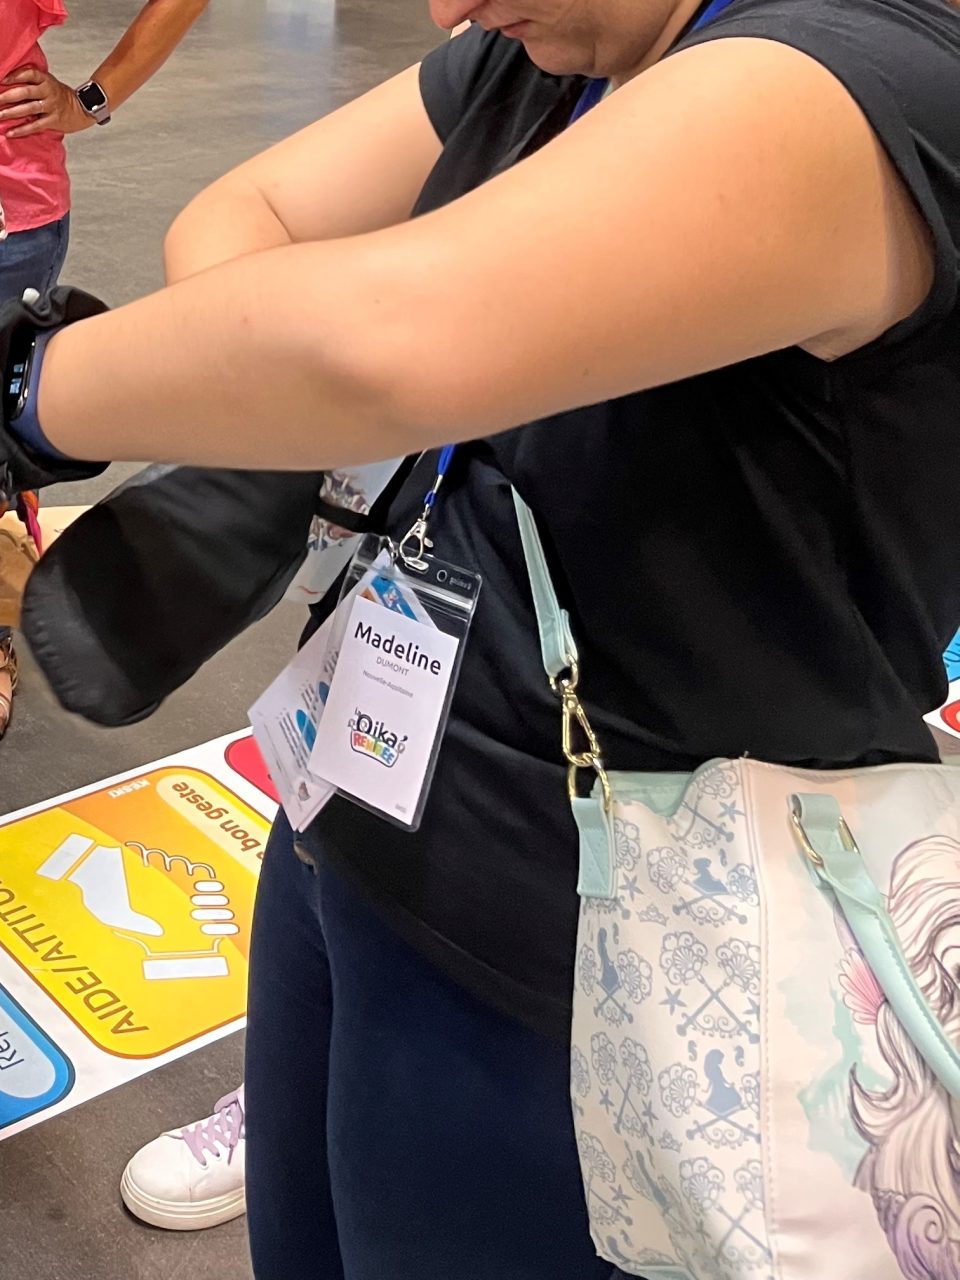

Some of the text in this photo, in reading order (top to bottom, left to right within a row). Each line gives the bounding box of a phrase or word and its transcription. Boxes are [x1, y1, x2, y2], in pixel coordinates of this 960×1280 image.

[354, 620, 441, 675] Madeline
[376, 656, 410, 677] DUMONT
[171, 780, 262, 853] bon geste
